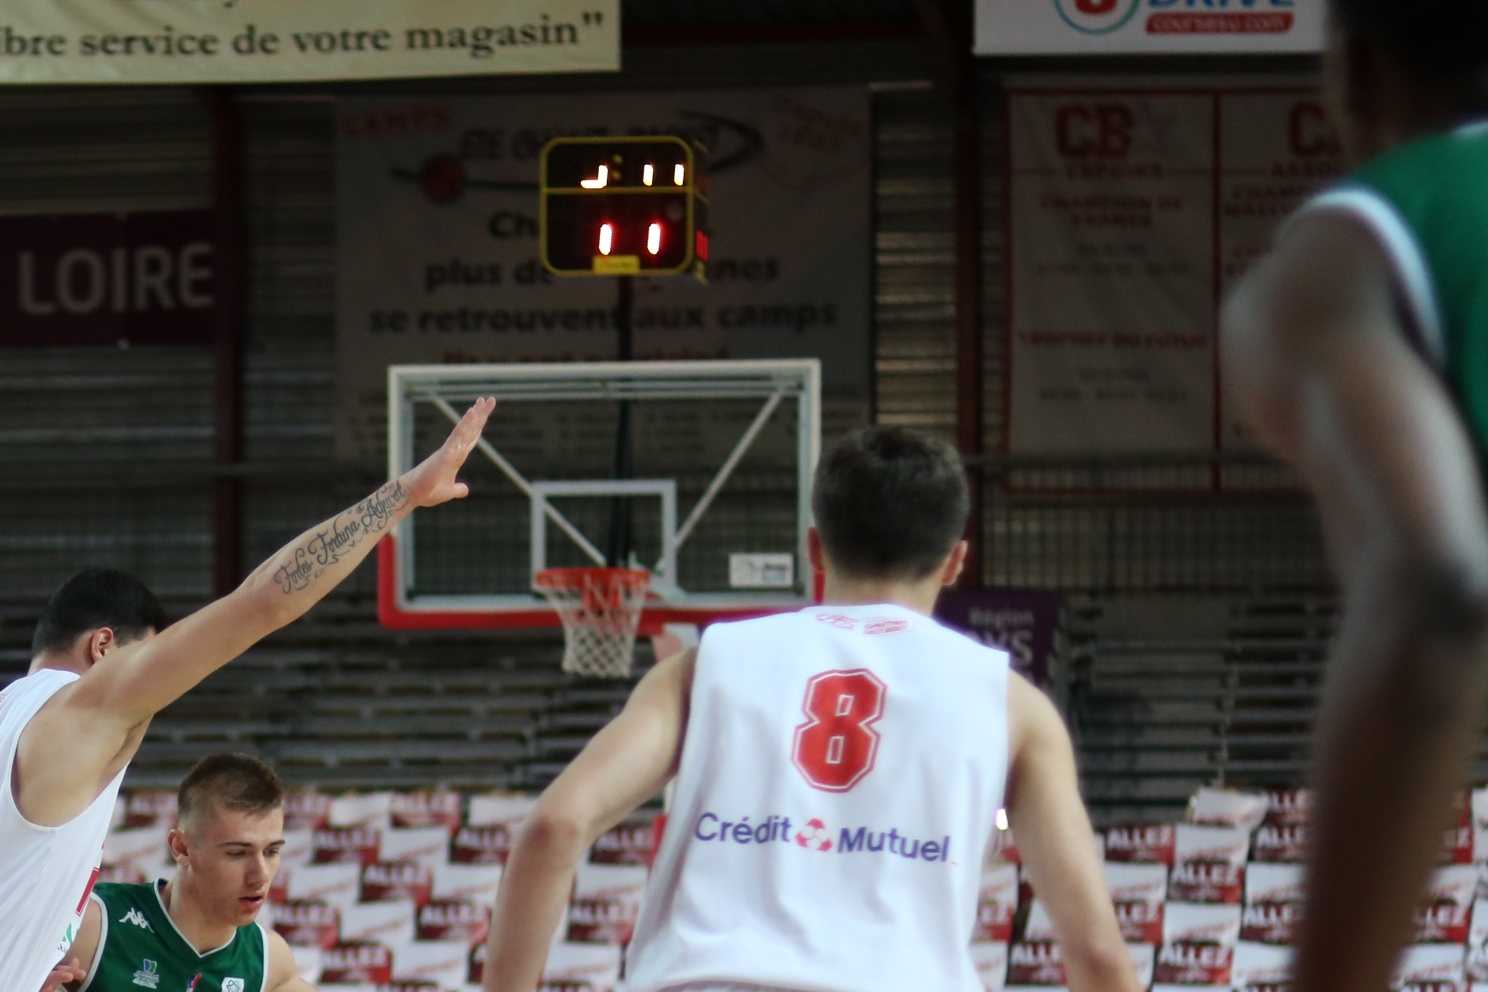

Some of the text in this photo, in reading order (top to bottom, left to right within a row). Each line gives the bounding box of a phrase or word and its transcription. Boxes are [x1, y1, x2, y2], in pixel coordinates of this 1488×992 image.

[79, 26, 219, 56] service
[232, 23, 279, 55] de
[292, 26, 390, 54] votre
[19, 241, 215, 315] LOIRE
[791, 668, 887, 793] 8
[694, 812, 950, 864] Crédit Mutuel
[1170, 863, 1239, 886] ALLEZ
[1157, 943, 1229, 967] ALLEZ
